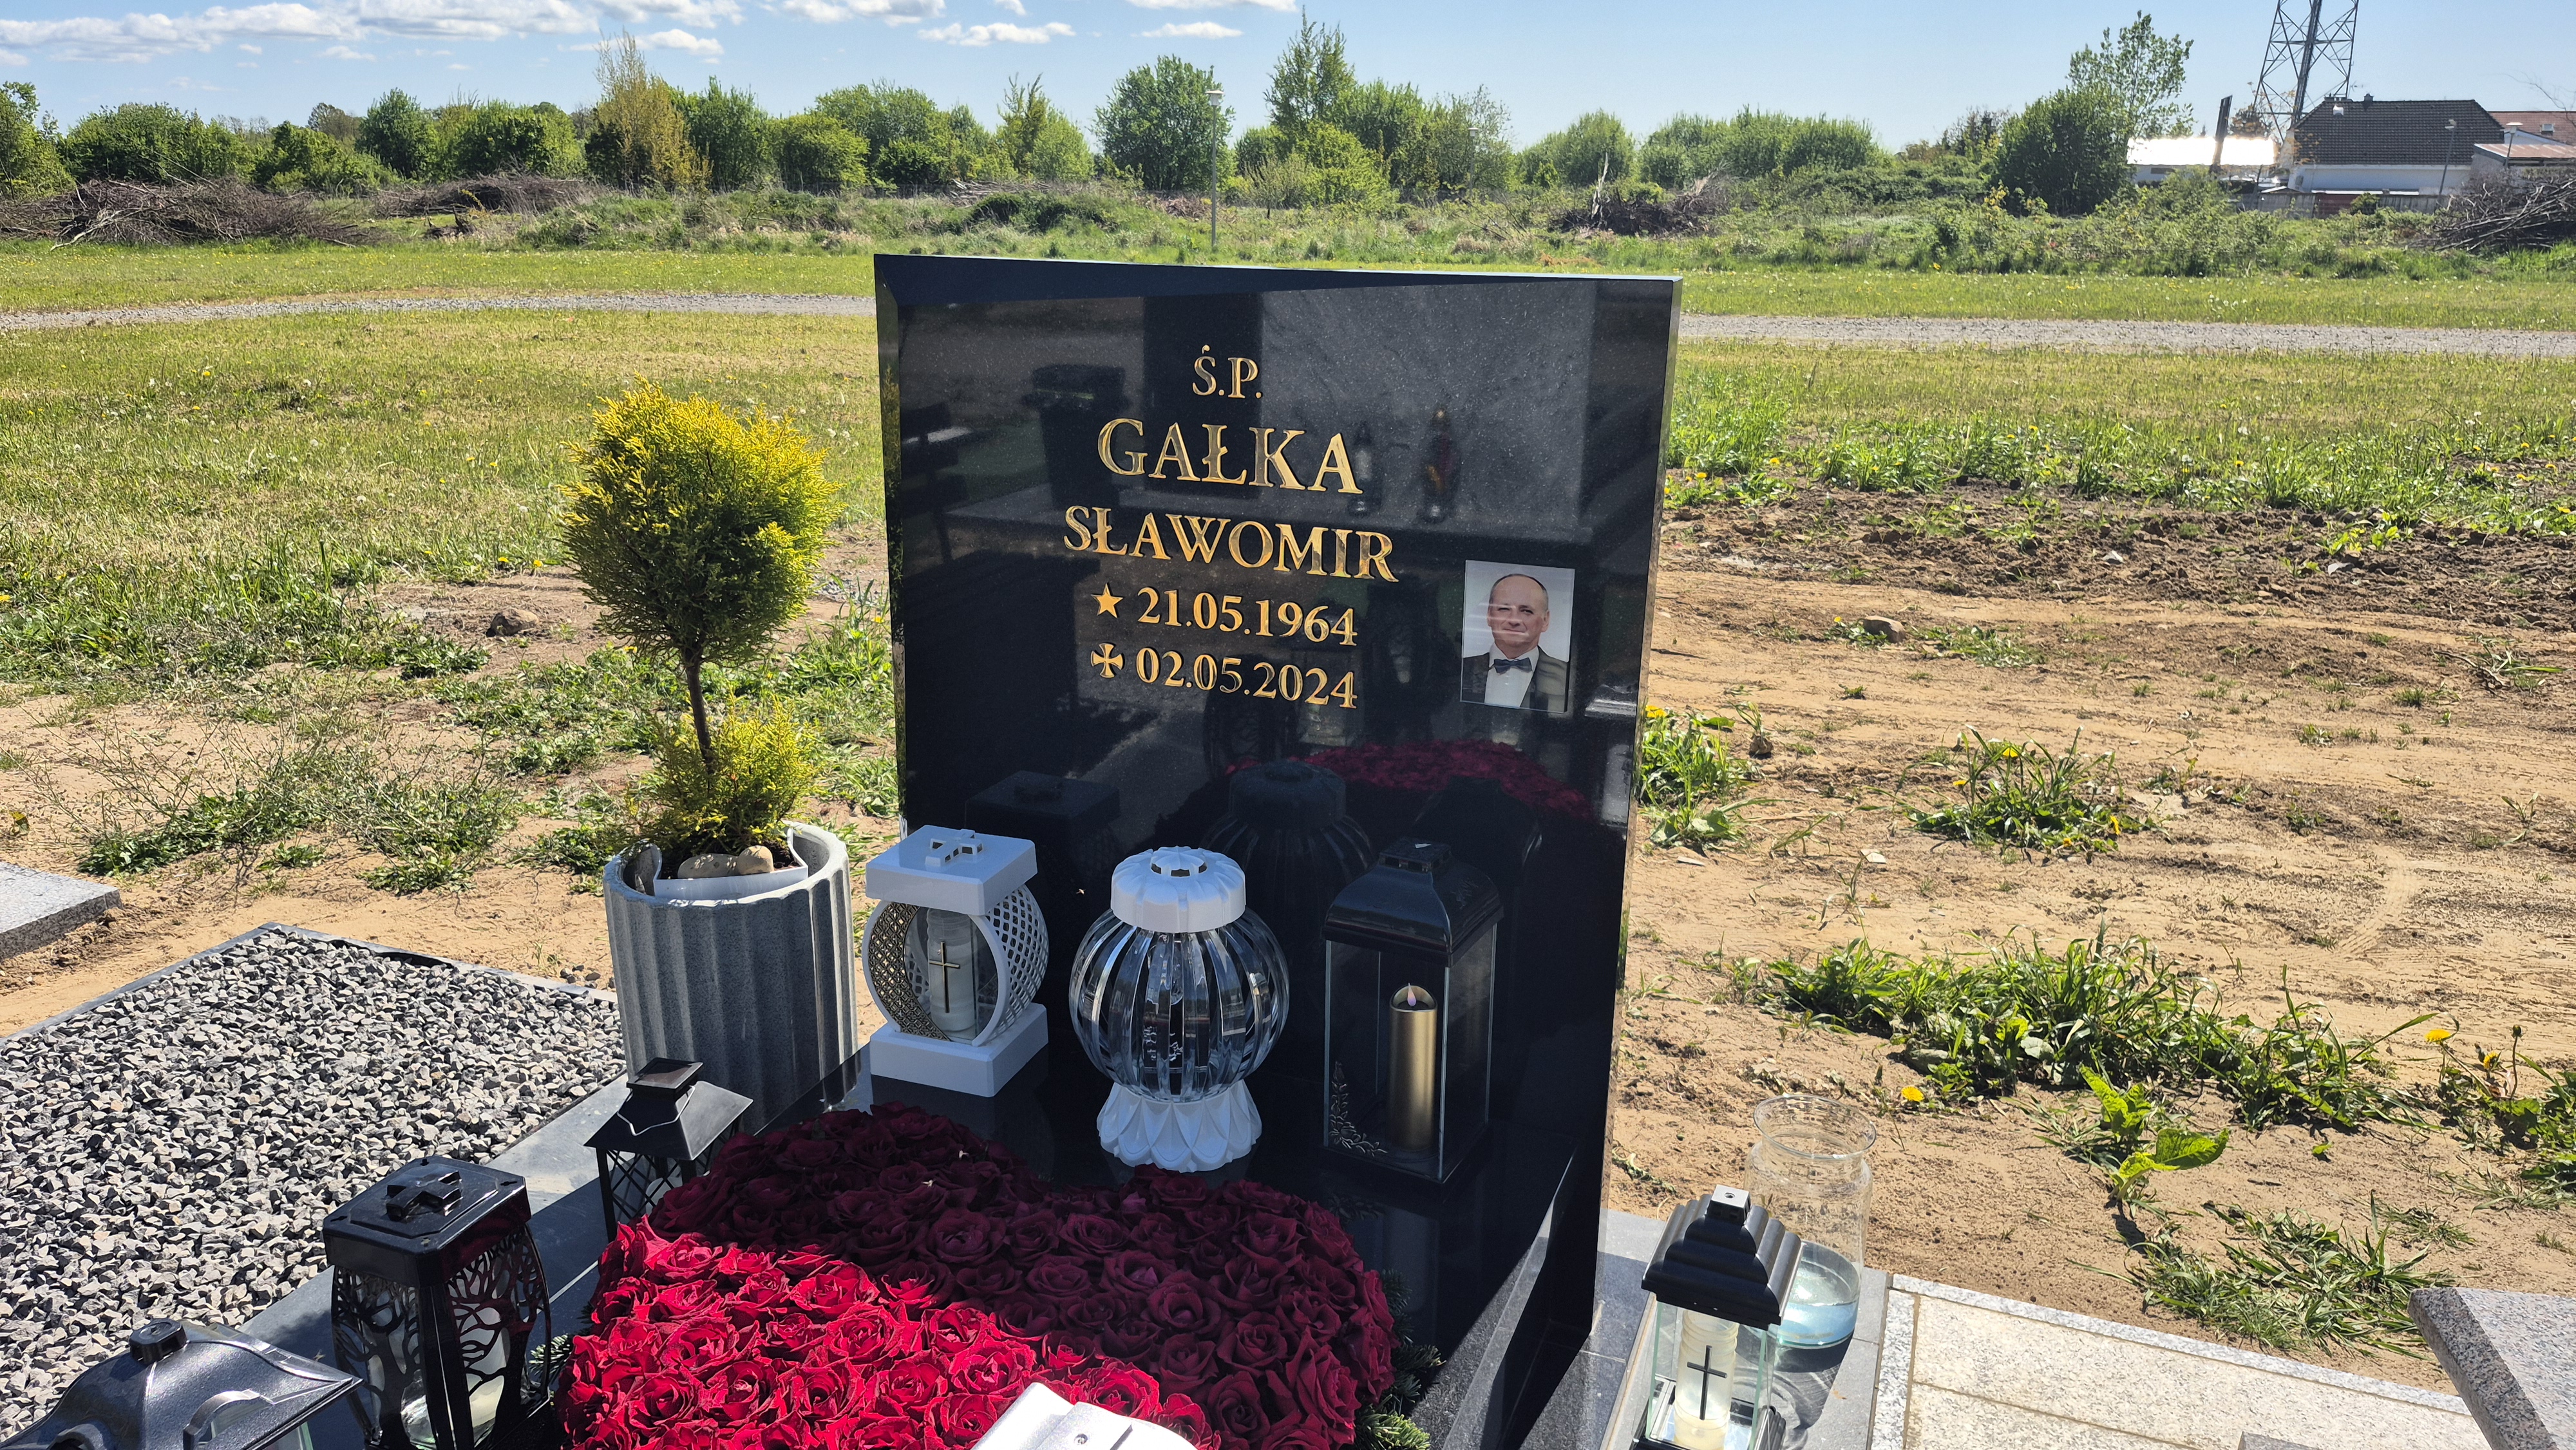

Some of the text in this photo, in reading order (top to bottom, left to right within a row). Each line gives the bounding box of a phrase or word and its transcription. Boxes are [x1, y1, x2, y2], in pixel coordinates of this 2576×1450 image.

[1192, 344, 1263, 399] Ś.P.
[1097, 418, 1363, 494] GAŁKA
[1063, 505, 1399, 582] SŁAWOMIR
[1138, 587, 1358, 646] 21.05.1964
[1135, 647, 1357, 709] 02.05.2024
